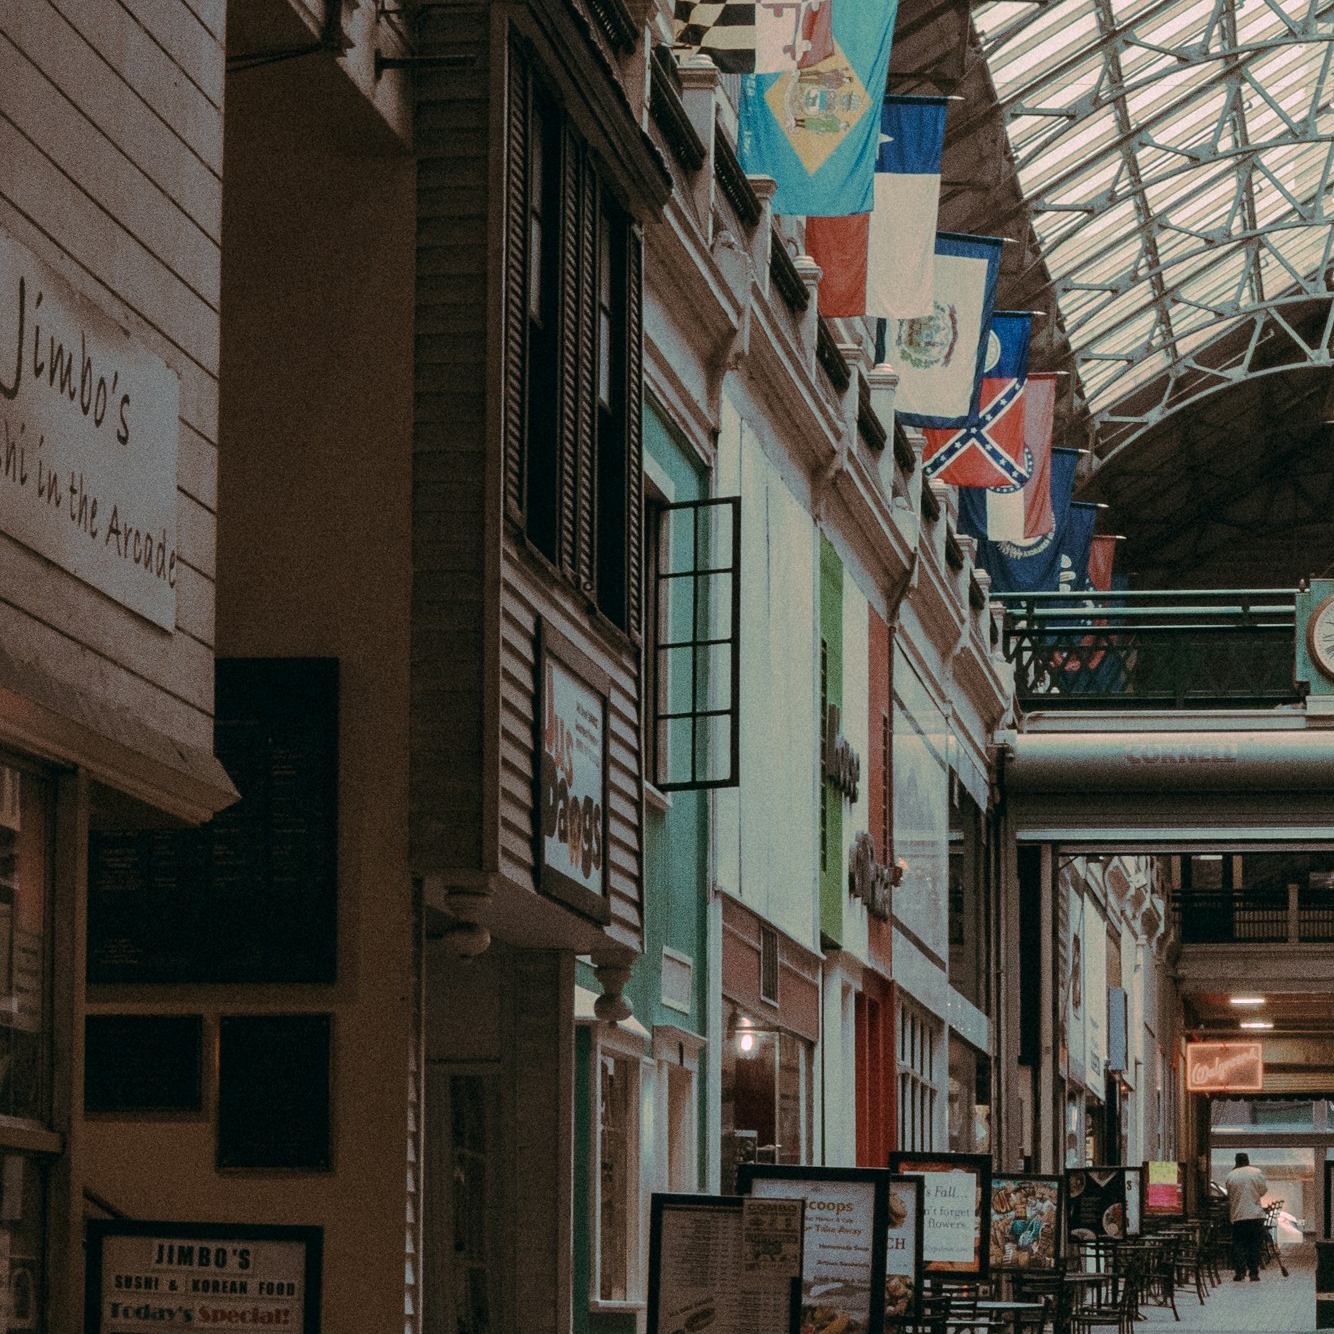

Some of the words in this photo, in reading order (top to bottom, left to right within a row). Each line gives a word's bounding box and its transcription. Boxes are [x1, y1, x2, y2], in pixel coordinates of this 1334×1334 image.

[0, 276, 131, 446] Jimbo's
[37, 435, 62, 508] in
[70, 471, 98, 540] the
[105, 504, 177, 589] Arcade
[939, 1207, 970, 1219] forget
[155, 1243, 252, 1271] JIMBO'S
[114, 1274, 160, 1291] SUSHI
[168, 1279, 178, 1292] &
[191, 1278, 249, 1295] KOREAN
[258, 1280, 296, 1297] FOOD
[111, 1301, 194, 1323] Today's
[197, 1305, 291, 1326] Special!
